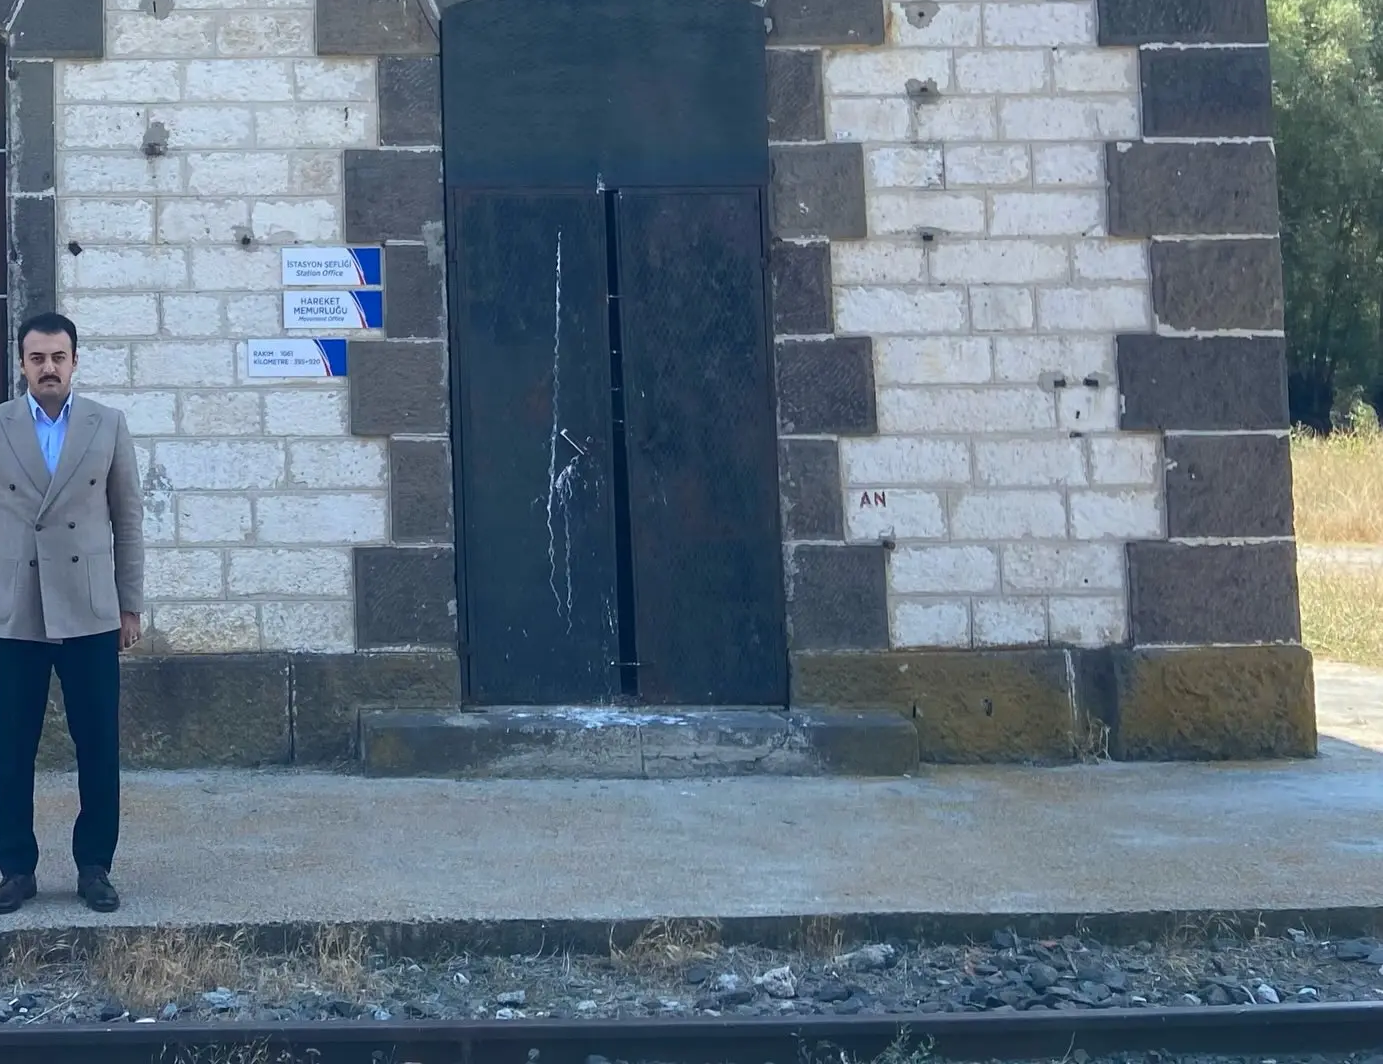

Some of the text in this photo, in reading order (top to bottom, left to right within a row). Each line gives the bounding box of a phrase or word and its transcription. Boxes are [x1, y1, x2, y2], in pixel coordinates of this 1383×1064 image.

[296, 269, 344, 277] Station Office
[300, 297, 340, 305] HAREKET
[293, 306, 348, 315] MEMURLUĞU
[860, 491, 886, 508] AN
